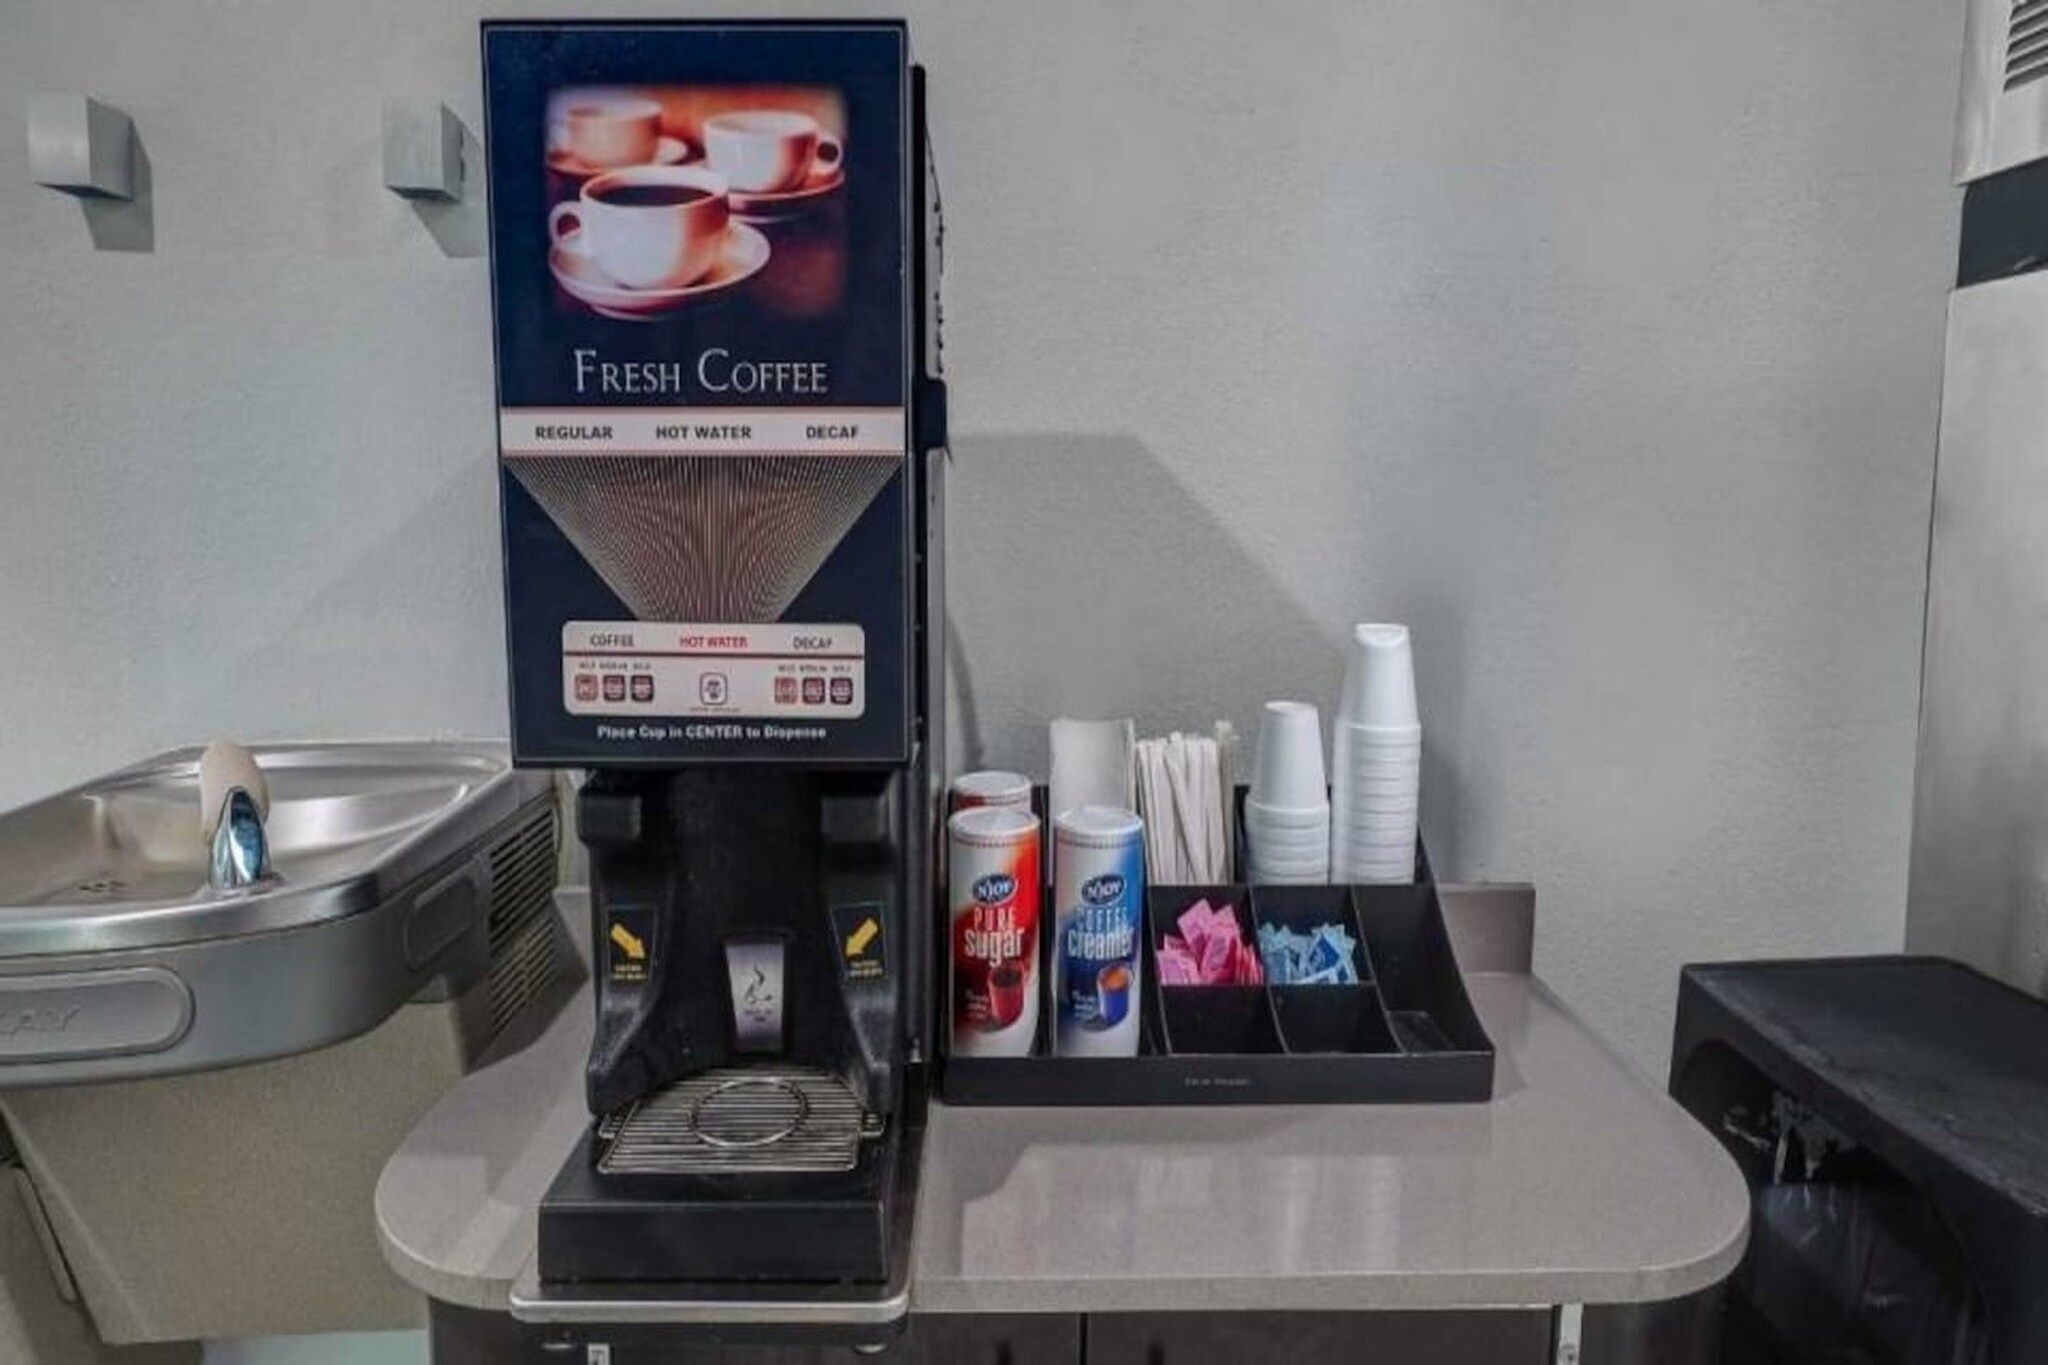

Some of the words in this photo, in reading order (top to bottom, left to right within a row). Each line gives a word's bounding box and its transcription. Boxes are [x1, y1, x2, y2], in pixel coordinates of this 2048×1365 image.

[534, 424, 614, 440] REGULAR
[655, 425, 690, 440] HOT
[695, 425, 752, 440] WATER
[805, 425, 860, 440] DECAF
[589, 634, 634, 647] COFFEE
[679, 636, 705, 648] HOT
[707, 636, 748, 648] WATER
[793, 636, 833, 649] DECAF
[597, 725, 635, 738] Place
[639, 725, 666, 740] Cup
[669, 725, 682, 738] in
[686, 725, 743, 738] CENTER
[747, 725, 760, 738] to
[764, 726, 827, 741] Dispense
[974, 906, 1015, 931] PURE
[964, 927, 1025, 968] sugar
